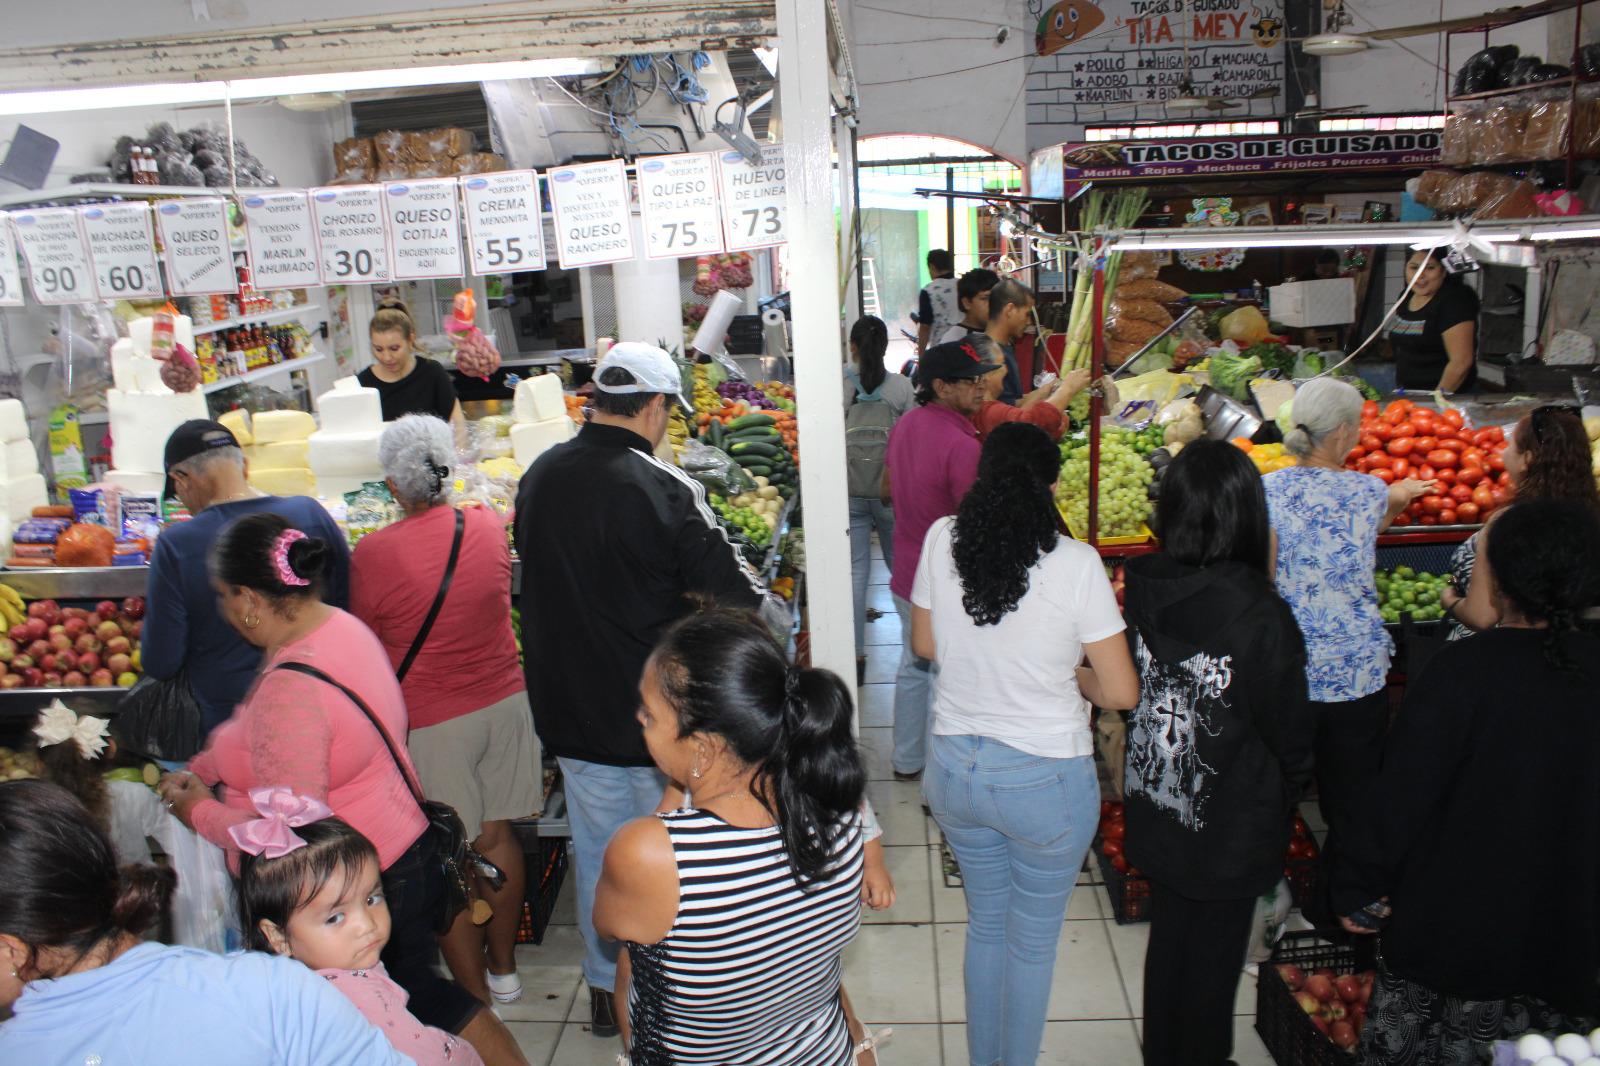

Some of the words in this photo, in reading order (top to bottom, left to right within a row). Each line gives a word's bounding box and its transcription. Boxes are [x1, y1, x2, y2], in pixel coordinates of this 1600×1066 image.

[1131, 0, 1169, 14] TACOS
[1087, 57, 1125, 71] POLLO
[1222, 52, 1269, 65] MACHACA
[1087, 74, 1128, 87] ADOBO
[1125, 142, 1237, 164] TACOS
[1242, 140, 1287, 160] DE
[1290, 132, 1444, 157] GUISADO
[1332, 157, 1388, 167] Puercos
[732, 168, 786, 186] HUEVO
[652, 180, 706, 197] QUESO
[735, 190, 750, 200] DE
[754, 186, 786, 198] LINEA
[478, 198, 526, 212] CREMA
[578, 194, 594, 202] VEN
[649, 201, 673, 210] TIPO
[676, 200, 690, 208] LA
[693, 196, 713, 206] PAZ
[563, 202, 606, 214] DISFRUTA
[323, 213, 377, 226] CHORIZO
[395, 208, 452, 224] QUESO
[480, 215, 529, 226] MENONITA
[573, 212, 614, 222] NUESTRO
[732, 218, 738, 230] $
[742, 206, 782, 237] 73
[259, 223, 302, 234] TENEMOS
[321, 230, 338, 238] DEL
[340, 227, 382, 238] ROSARIO
[402, 228, 448, 241] COTIJA
[570, 222, 622, 240] QUESO
[650, 232, 658, 244] $
[662, 222, 698, 248] 75
[91, 230, 146, 242] MACHACA
[172, 229, 220, 243] QUESO
[270, 234, 292, 244] RICO
[93, 246, 110, 254] DEL
[112, 242, 149, 252] ROSARIO
[176, 246, 220, 256] SELECTO
[263, 248, 306, 260] MARLIN
[476, 248, 483, 260] $
[486, 237, 524, 266] 55
[528, 249, 540, 258] KG
[567, 239, 628, 255] RANCHERO
[190, 256, 225, 281] ORIGINAL
[257, 261, 316, 275] AHUMADO
[325, 259, 332, 271] $
[335, 249, 372, 276] 30
[42, 266, 76, 293] 90
[110, 266, 143, 292] 60
[376, 270, 388, 278] KG
